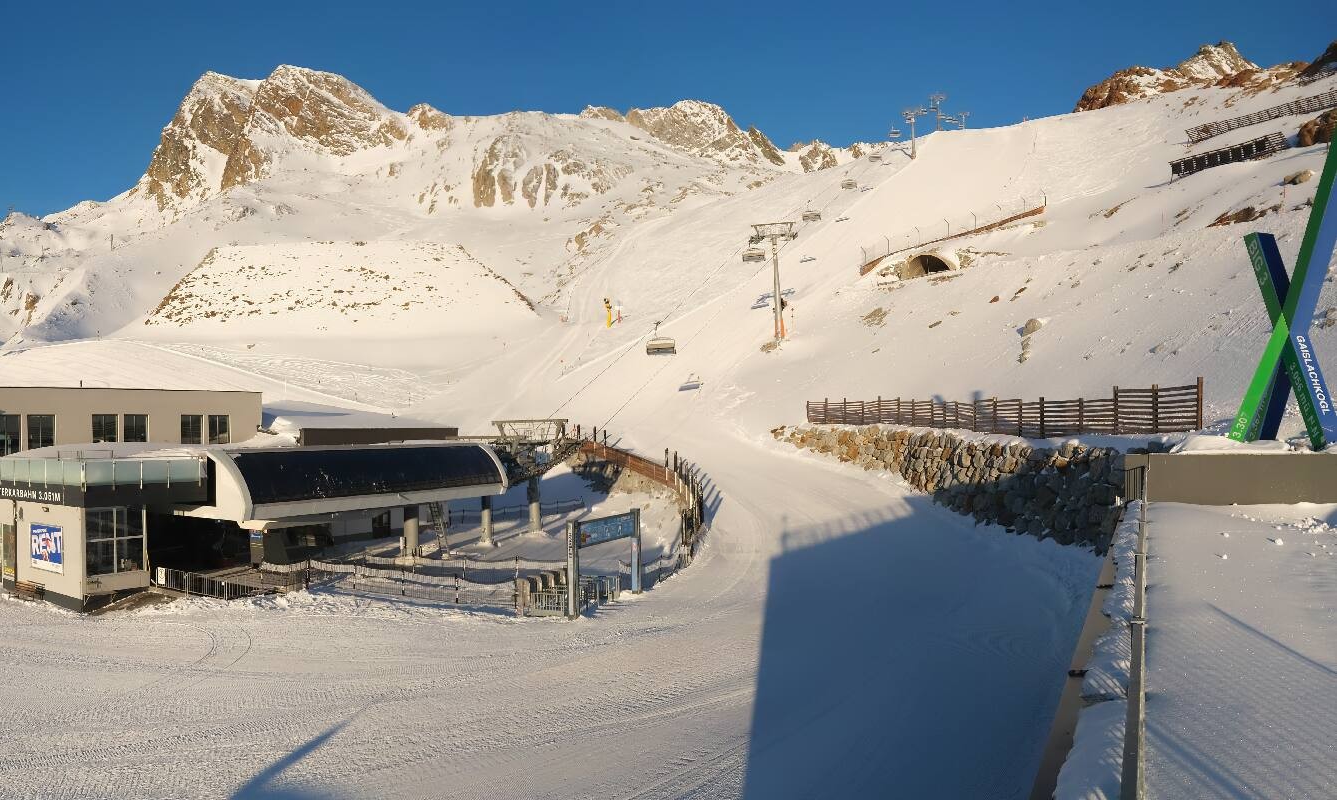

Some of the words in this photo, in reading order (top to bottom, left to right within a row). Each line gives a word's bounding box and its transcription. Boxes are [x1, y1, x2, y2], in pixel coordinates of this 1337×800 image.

[1248, 239, 1263, 272] BIG
[1259, 271, 1268, 286] 3
[1296, 335, 1331, 416] GAISLACHKOGL
[31, 531, 62, 556] RENT
